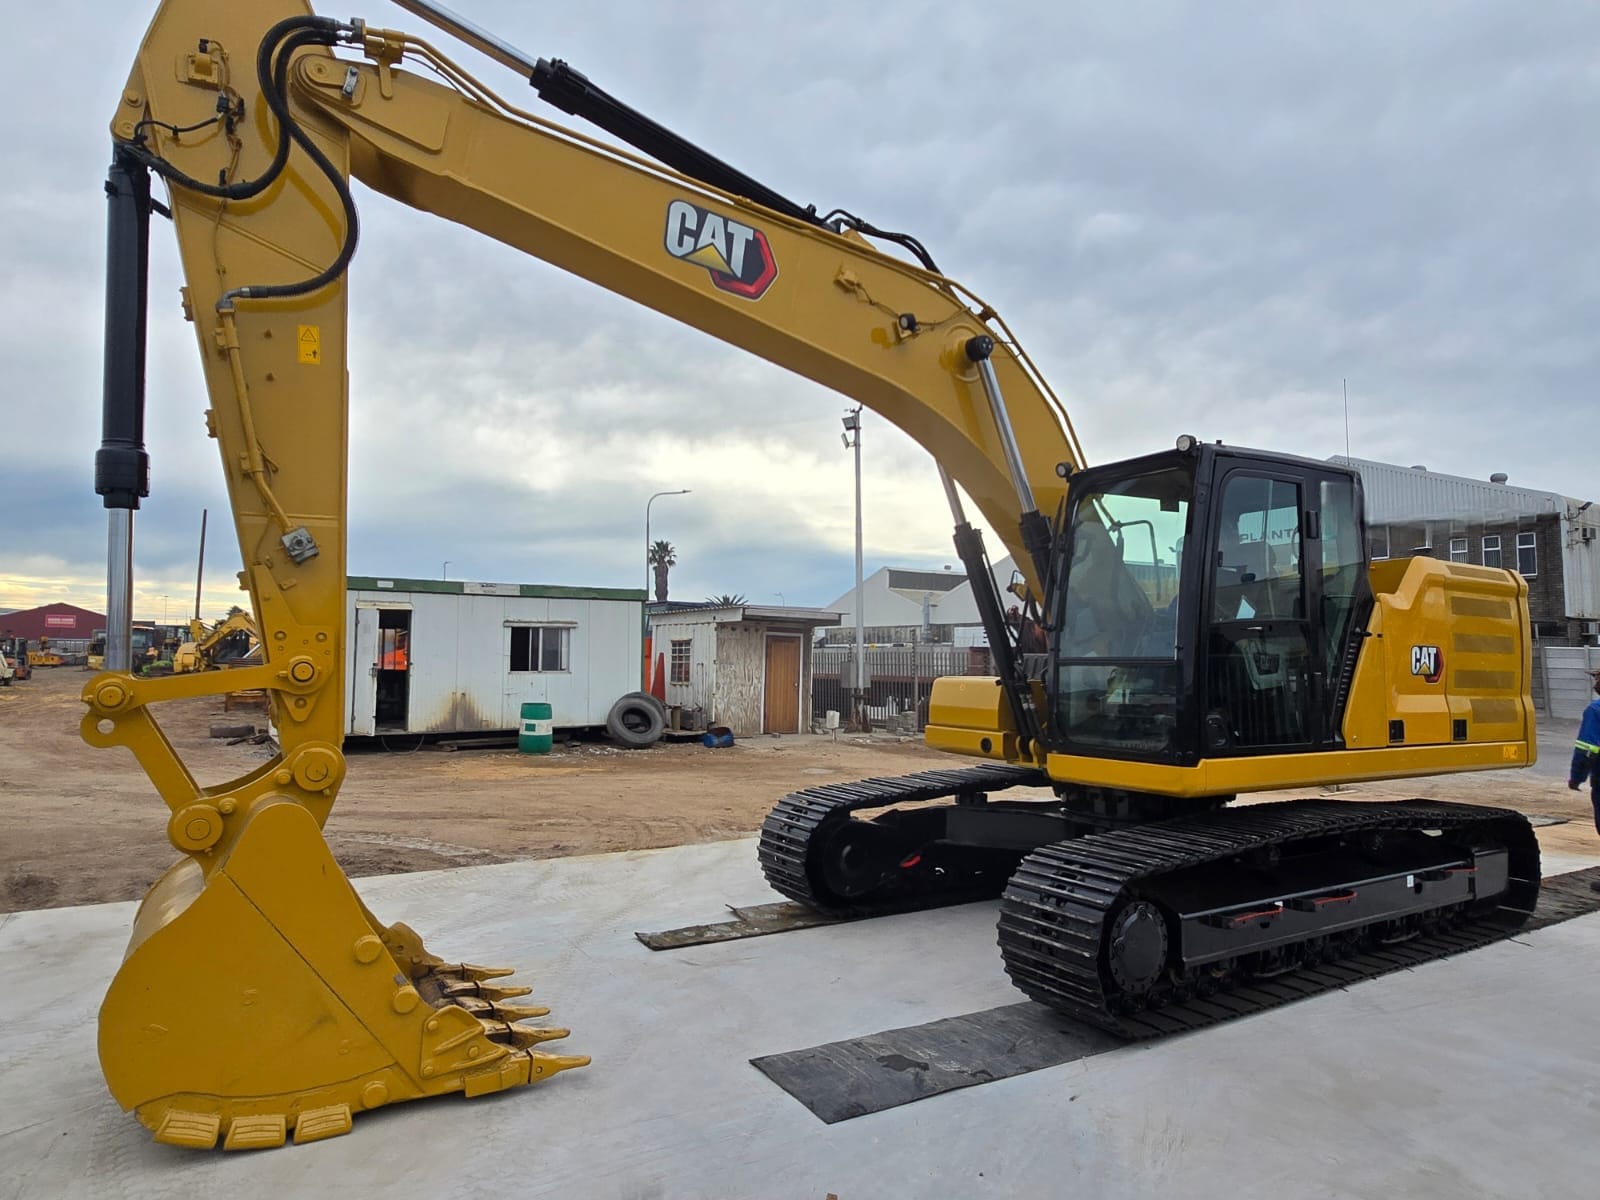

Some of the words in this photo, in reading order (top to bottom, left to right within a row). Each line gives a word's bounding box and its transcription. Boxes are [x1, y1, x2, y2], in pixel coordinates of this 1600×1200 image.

[666, 200, 754, 279] CAT
[1239, 528, 1294, 542] PLNT
[1411, 646, 1437, 675] CAT
